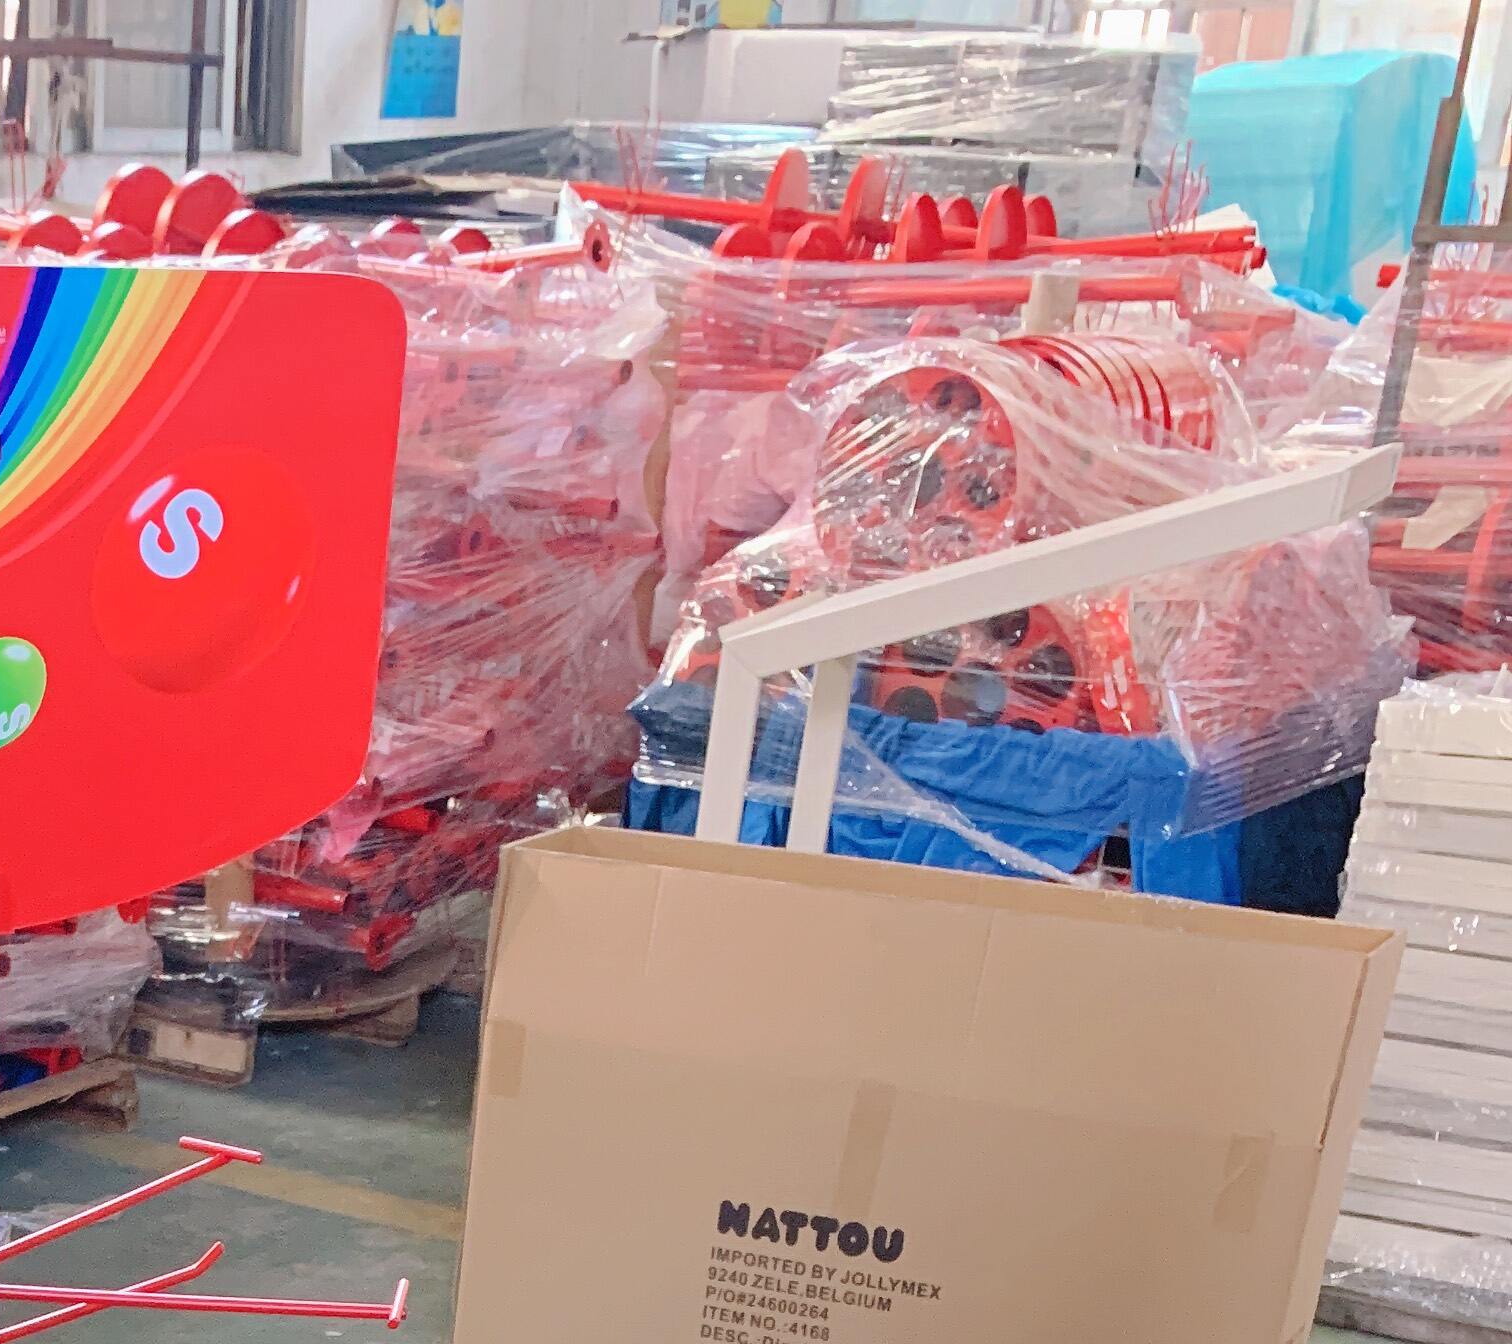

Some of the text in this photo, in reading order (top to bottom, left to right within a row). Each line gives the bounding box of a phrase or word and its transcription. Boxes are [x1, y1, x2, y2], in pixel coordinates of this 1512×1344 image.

[717, 1200, 904, 1262] NATTOU
[708, 1267, 748, 1286] 9240
[710, 1247, 943, 1300] IMPORTED BY JOLLYMEX
[702, 1306, 745, 1325] ITEM
